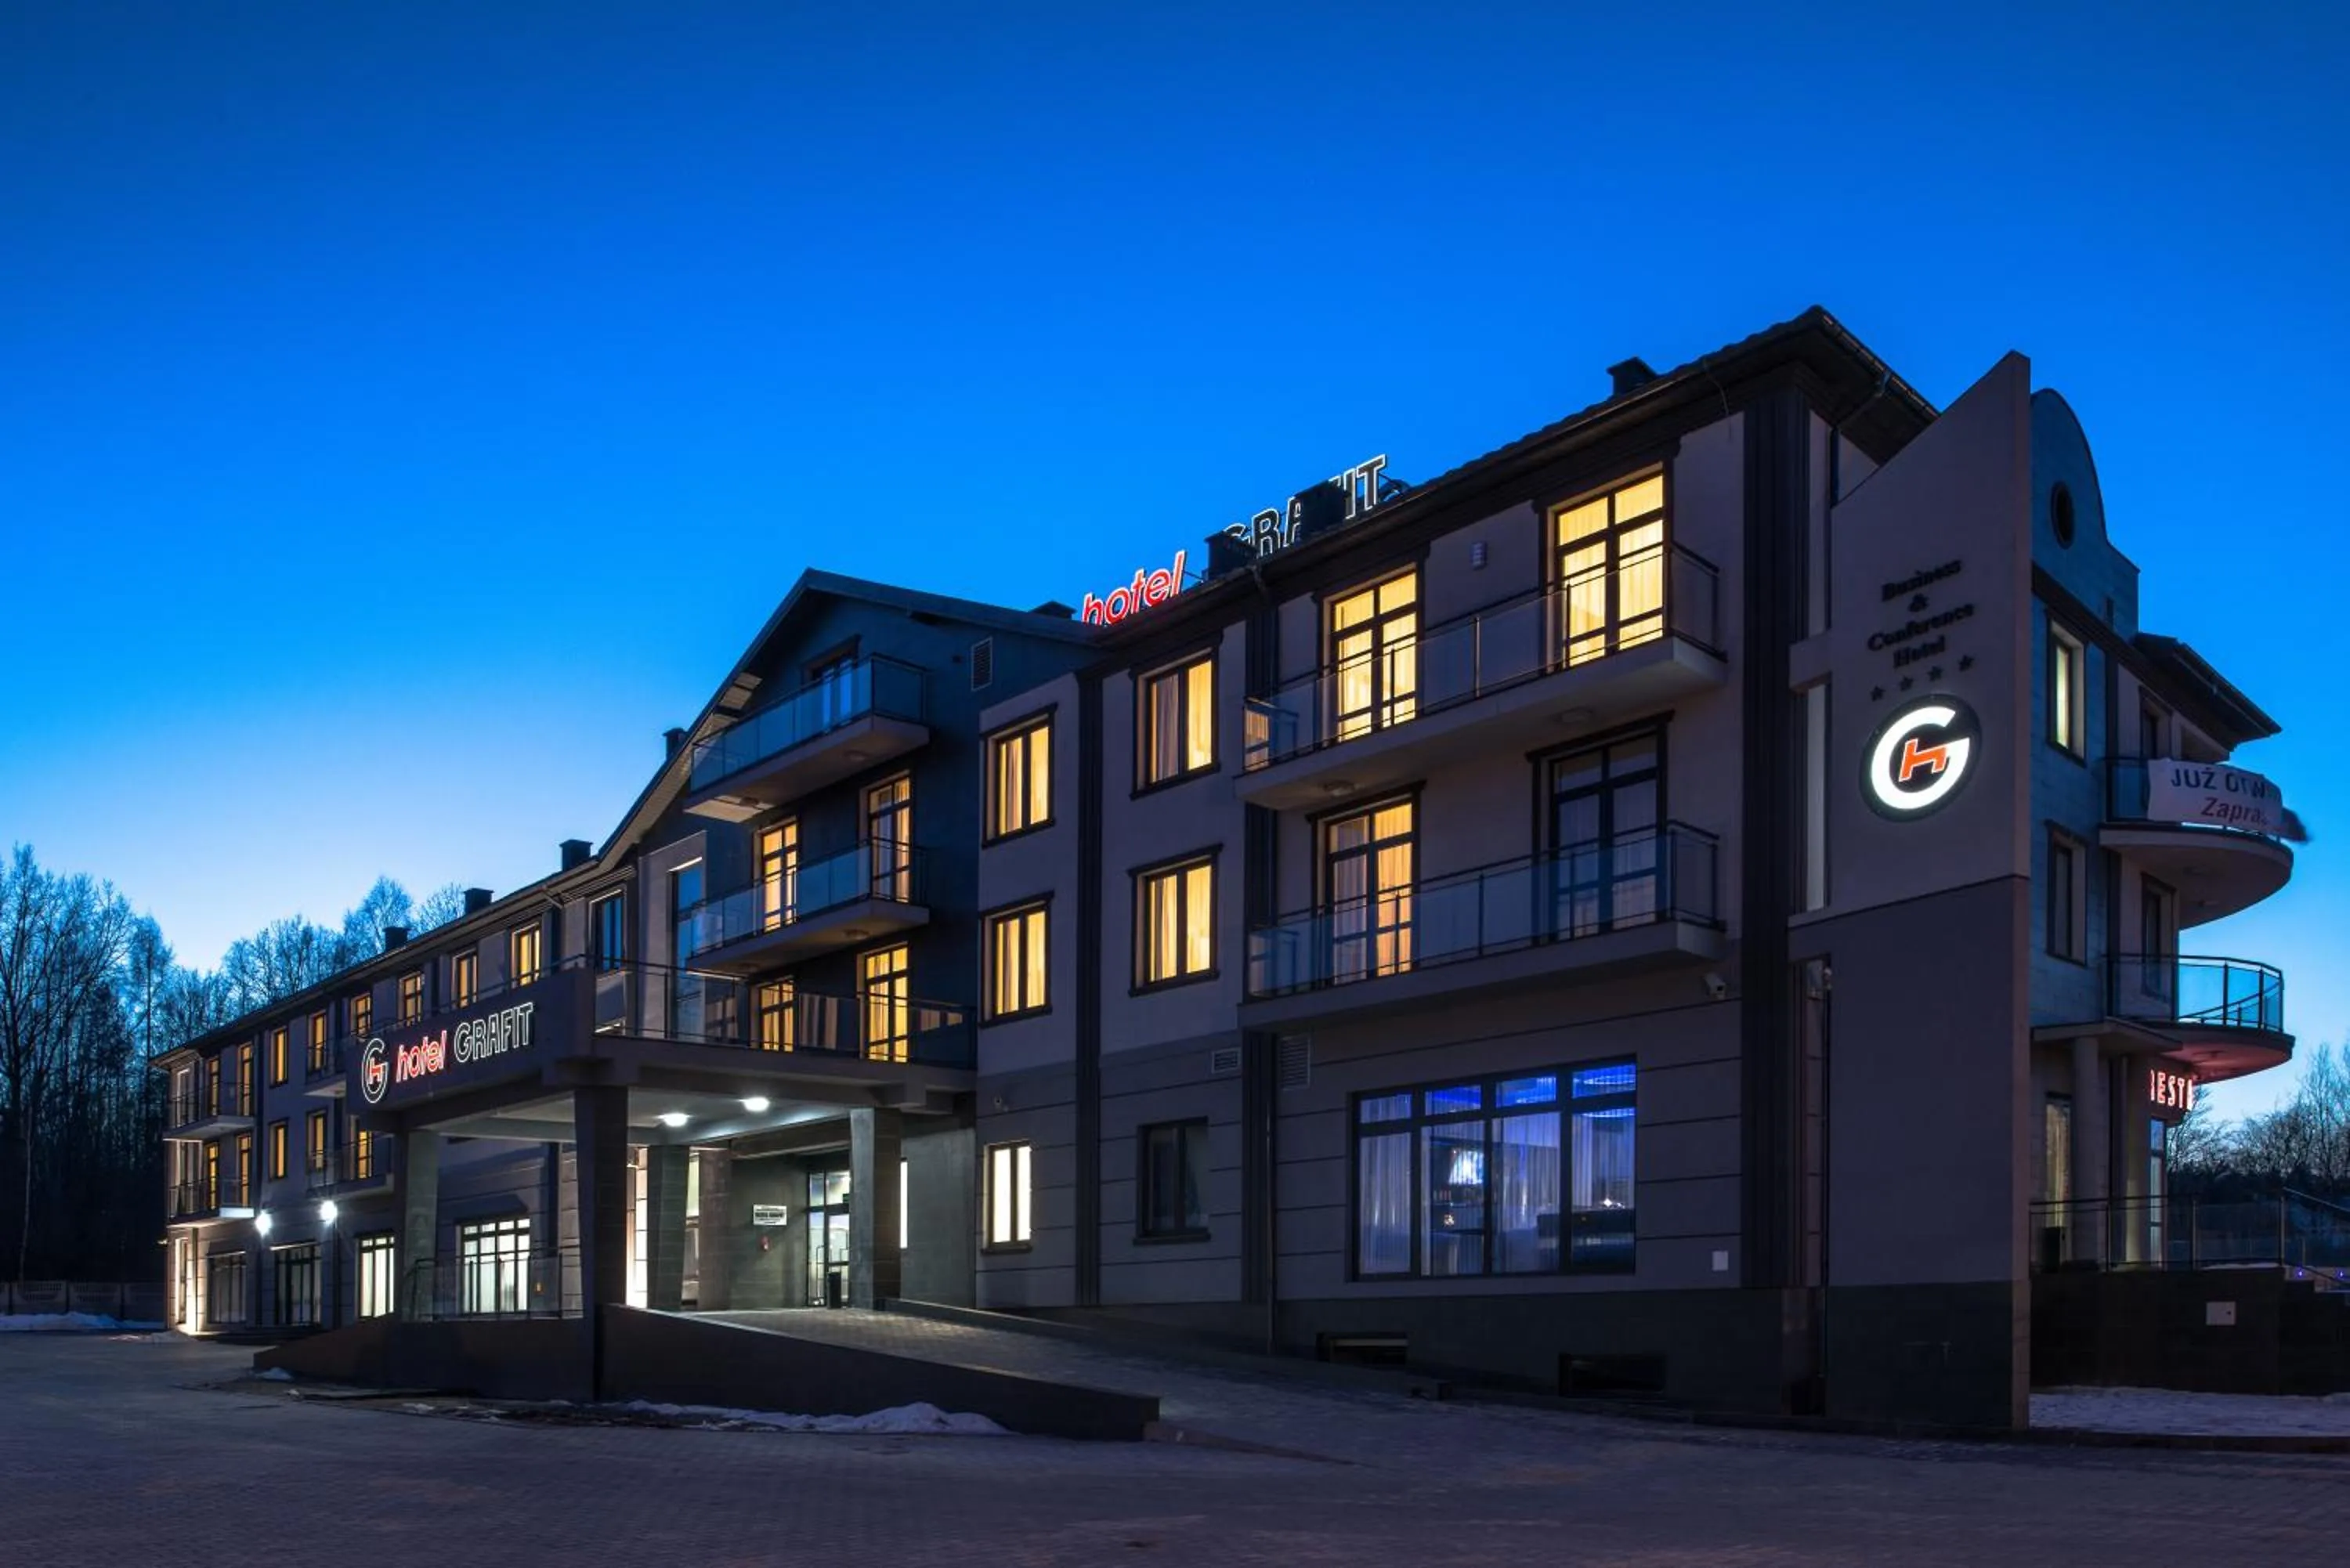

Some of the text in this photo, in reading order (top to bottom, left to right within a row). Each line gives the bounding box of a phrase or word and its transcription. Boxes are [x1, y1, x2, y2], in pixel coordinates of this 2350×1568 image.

[1082, 550, 1186, 627] hotel
[2170, 767, 2217, 790] JUŻ
[396, 1030, 447, 1083] hotel
[454, 1002, 533, 1063] GRAFIT
